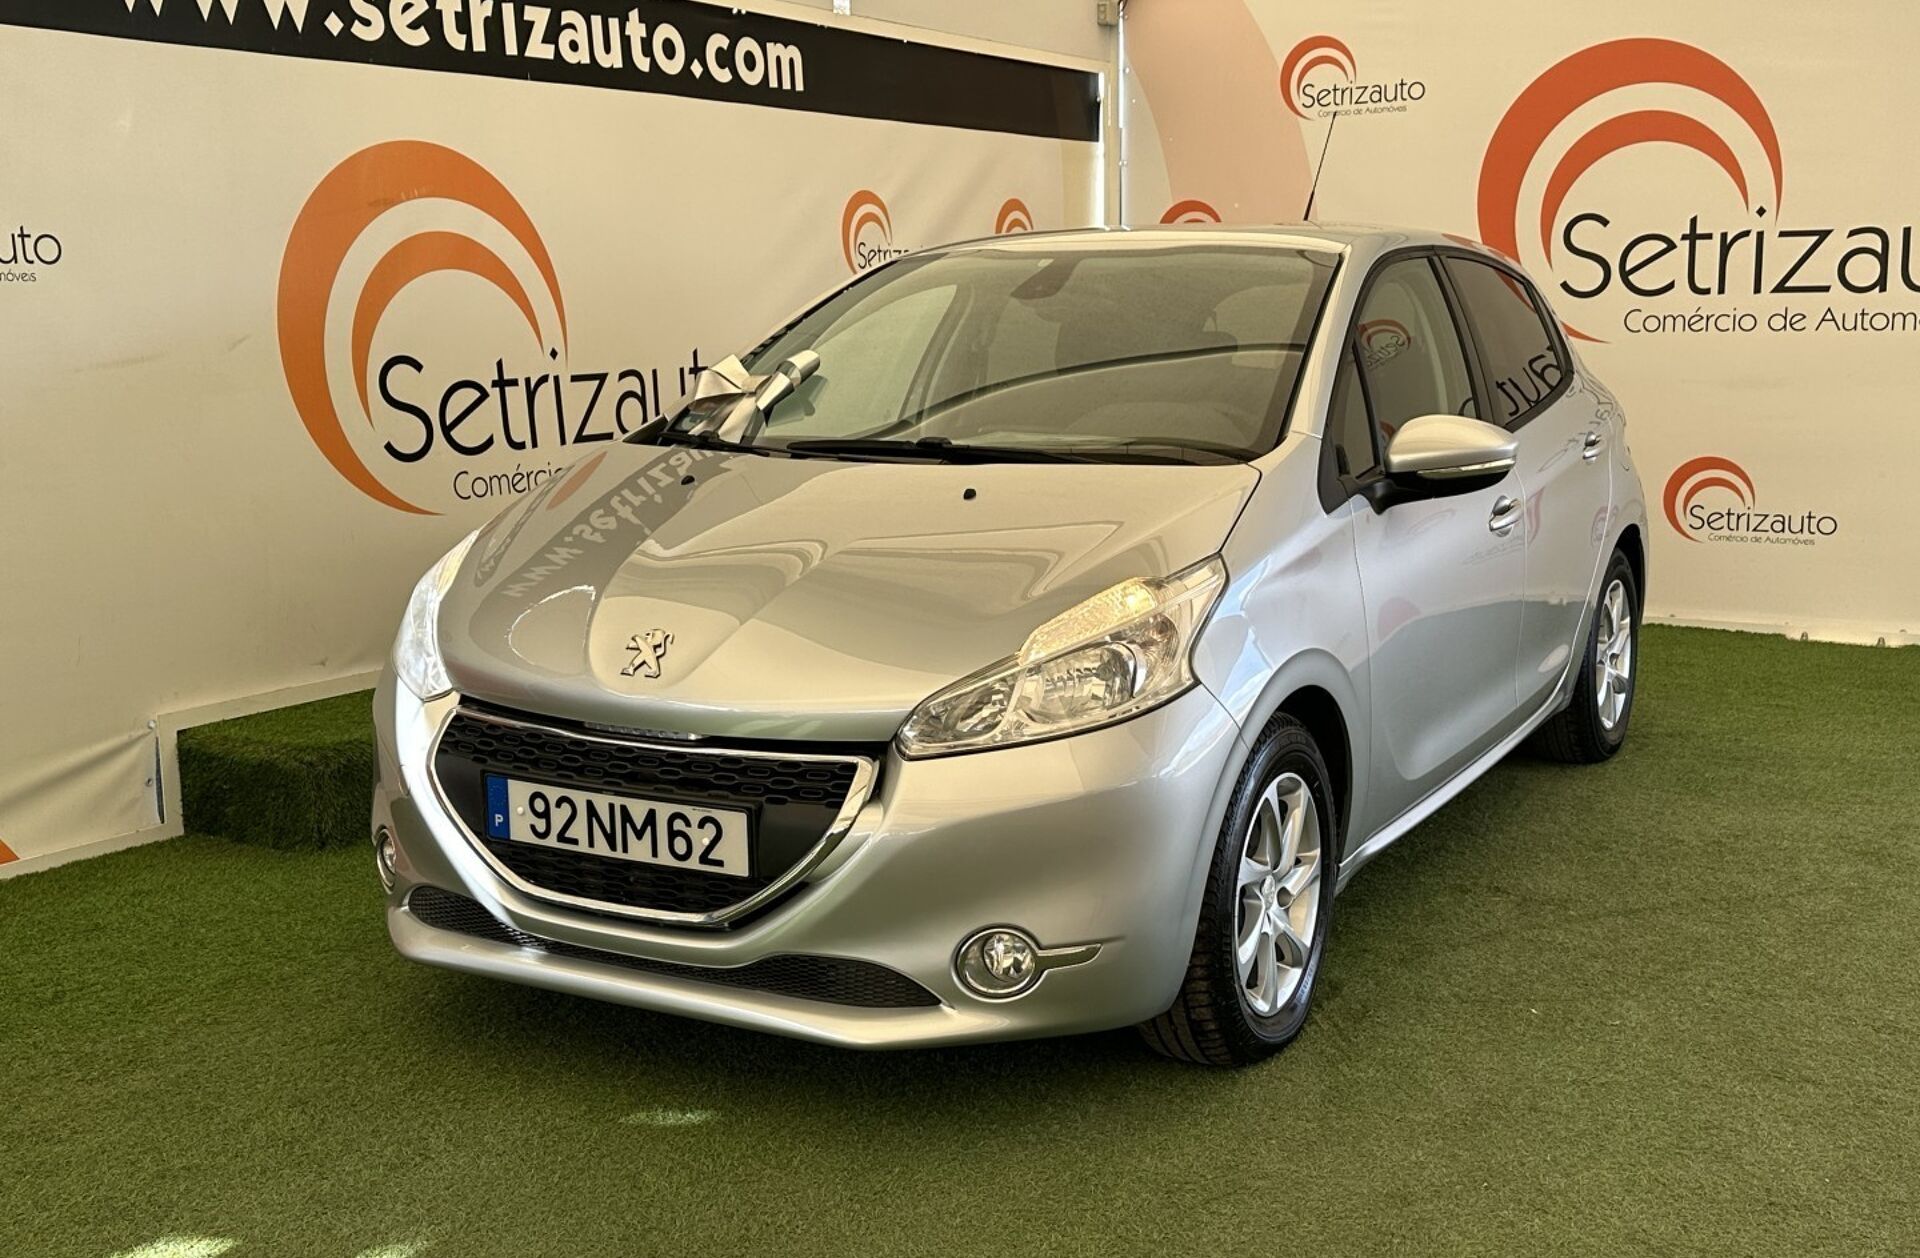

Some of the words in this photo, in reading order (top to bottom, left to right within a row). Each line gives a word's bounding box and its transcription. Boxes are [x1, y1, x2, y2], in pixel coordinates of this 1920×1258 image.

[124, 0, 804, 92] w.setrizauto.com
[1302, 78, 1426, 109] Setrizauto
[1623, 306, 1757, 334] Comércio
[1767, 306, 1807, 333] de
[1815, 306, 1920, 333] Autom
[1688, 504, 1838, 536] Setrizauto
[1707, 531, 1749, 544] Comércio
[1750, 535, 1762, 544] de
[1763, 535, 1816, 547] Automóveis
[494, 813, 504, 827] P
[527, 790, 725, 868] 92NM62
